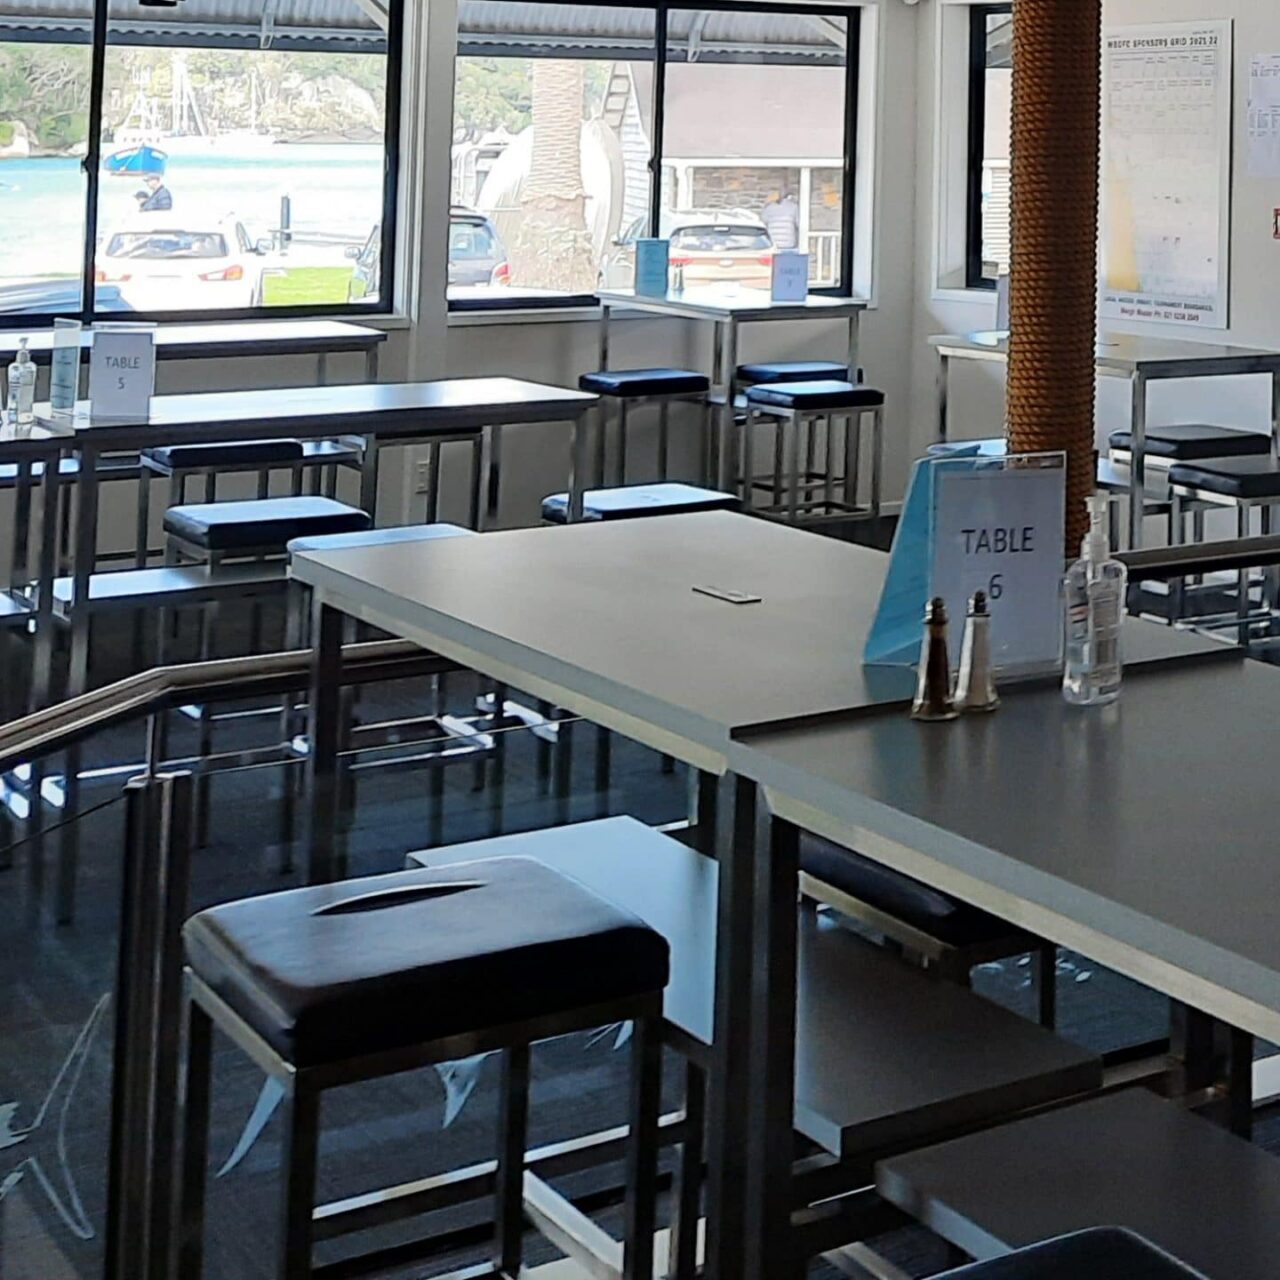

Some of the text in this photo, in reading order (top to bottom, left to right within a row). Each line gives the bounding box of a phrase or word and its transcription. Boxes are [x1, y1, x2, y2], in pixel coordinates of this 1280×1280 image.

[1132, 38, 1168, 47] SPONSORS
[1170, 37, 1188, 46] GRID
[105, 356, 140, 369] TABLE
[117, 376, 125, 390] 5
[961, 526, 1036, 555] TABLE
[988, 573, 1003, 600] 6
